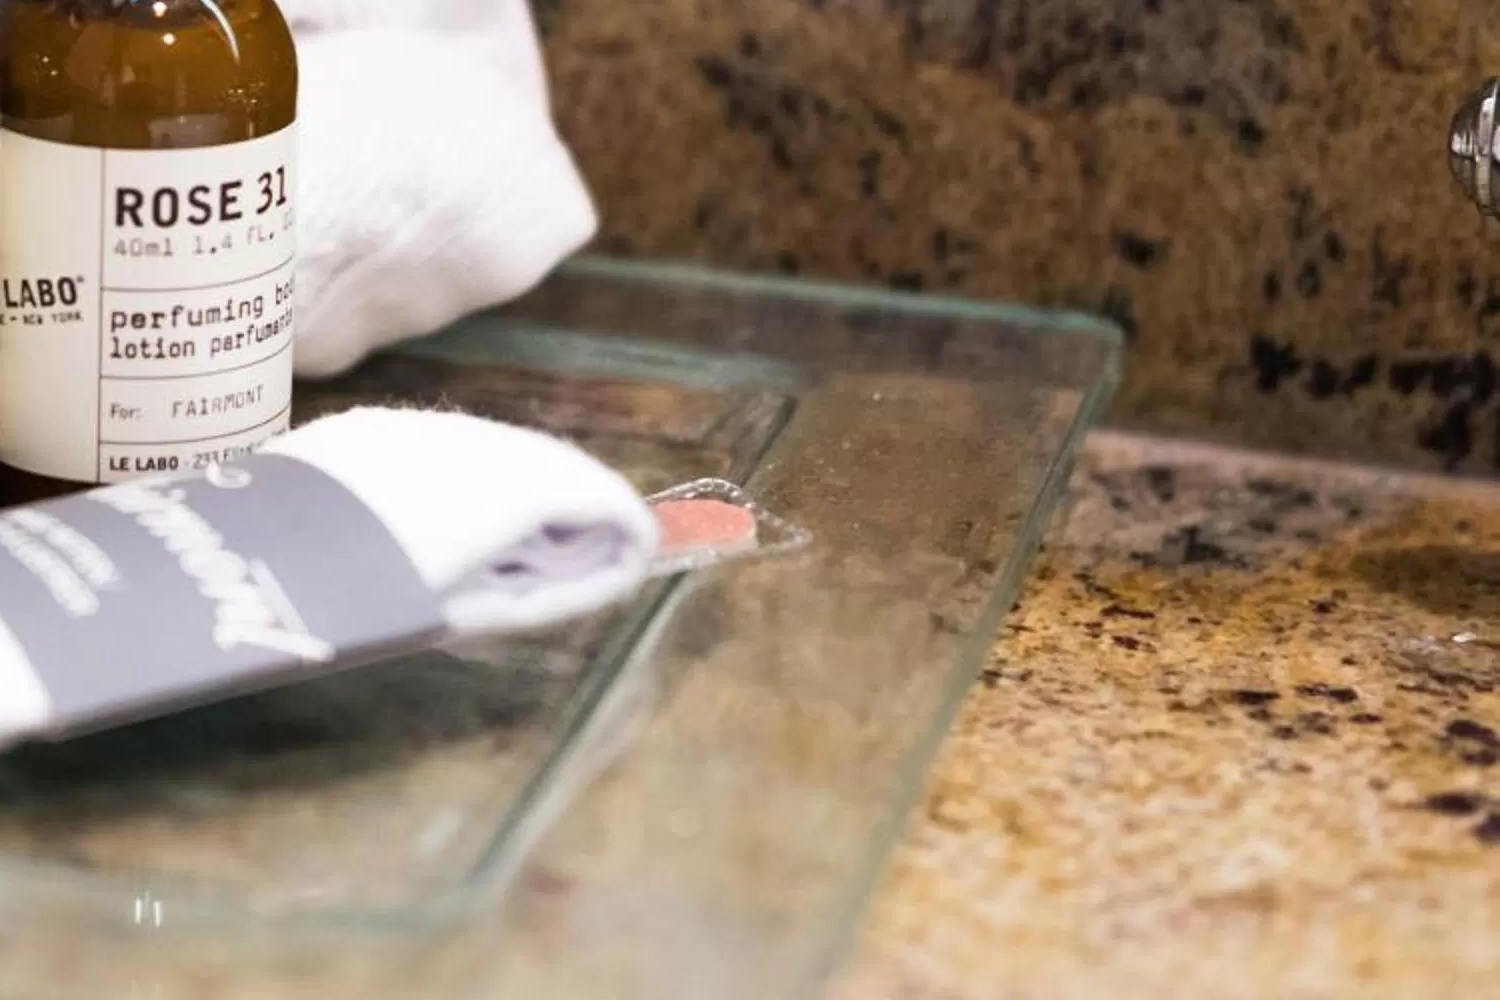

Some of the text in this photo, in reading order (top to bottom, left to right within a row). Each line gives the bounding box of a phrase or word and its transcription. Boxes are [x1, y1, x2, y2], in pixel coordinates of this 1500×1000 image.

[114, 180, 243, 228] ROSE
[256, 165, 288, 215] 31
[113, 237, 174, 257] 40ml
[192, 232, 233, 256] 1.4
[3, 276, 77, 309] LABO
[110, 296, 265, 333] perfuming
[110, 336, 196, 360] lotion
[172, 384, 265, 419] FAIRMONT
[109, 456, 130, 472] LE
[134, 455, 180, 472] LABO
